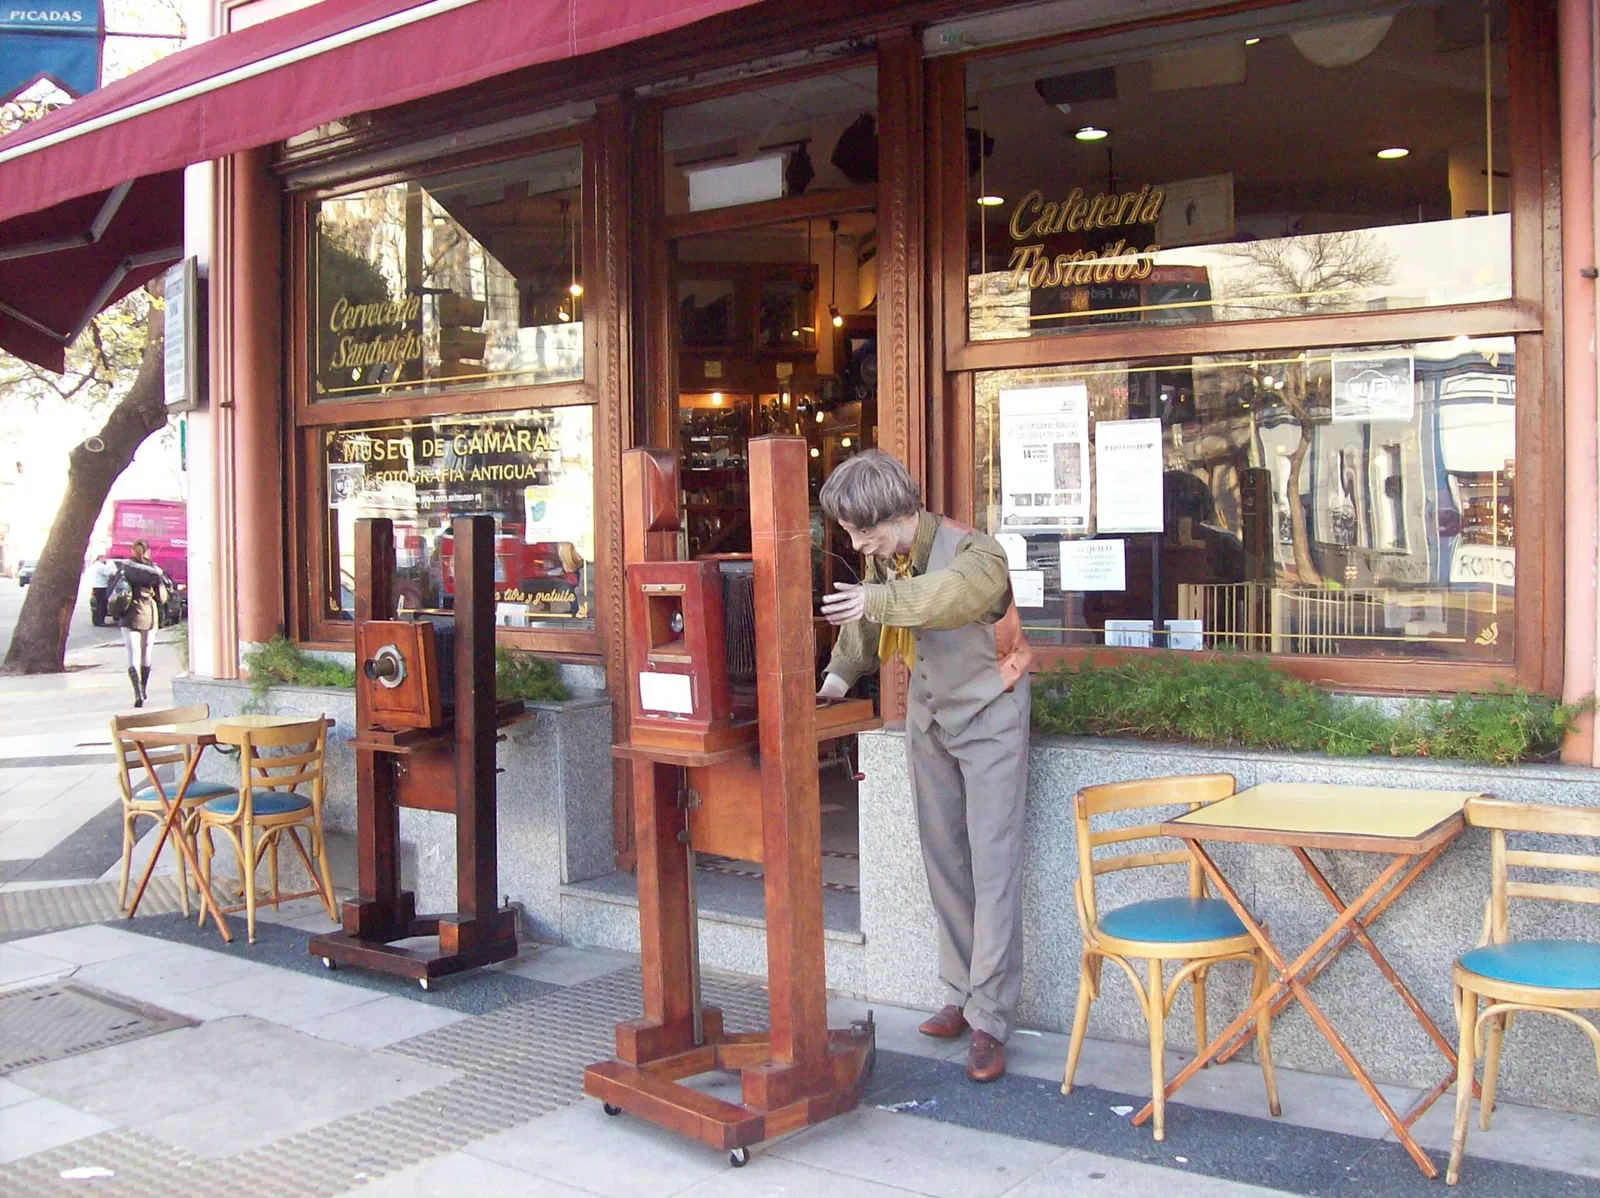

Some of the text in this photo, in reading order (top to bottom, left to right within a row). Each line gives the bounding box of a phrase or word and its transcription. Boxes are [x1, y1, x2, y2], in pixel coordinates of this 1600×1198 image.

[9, 10, 82, 22] PICADAS
[1008, 239, 1161, 291] Tostados
[343, 439, 414, 462] MUSEO
[422, 439, 445, 458] DE
[470, 464, 536, 481] ANTIGUA
[525, 593, 533, 604] y
[533, 588, 575, 606] gratuita
